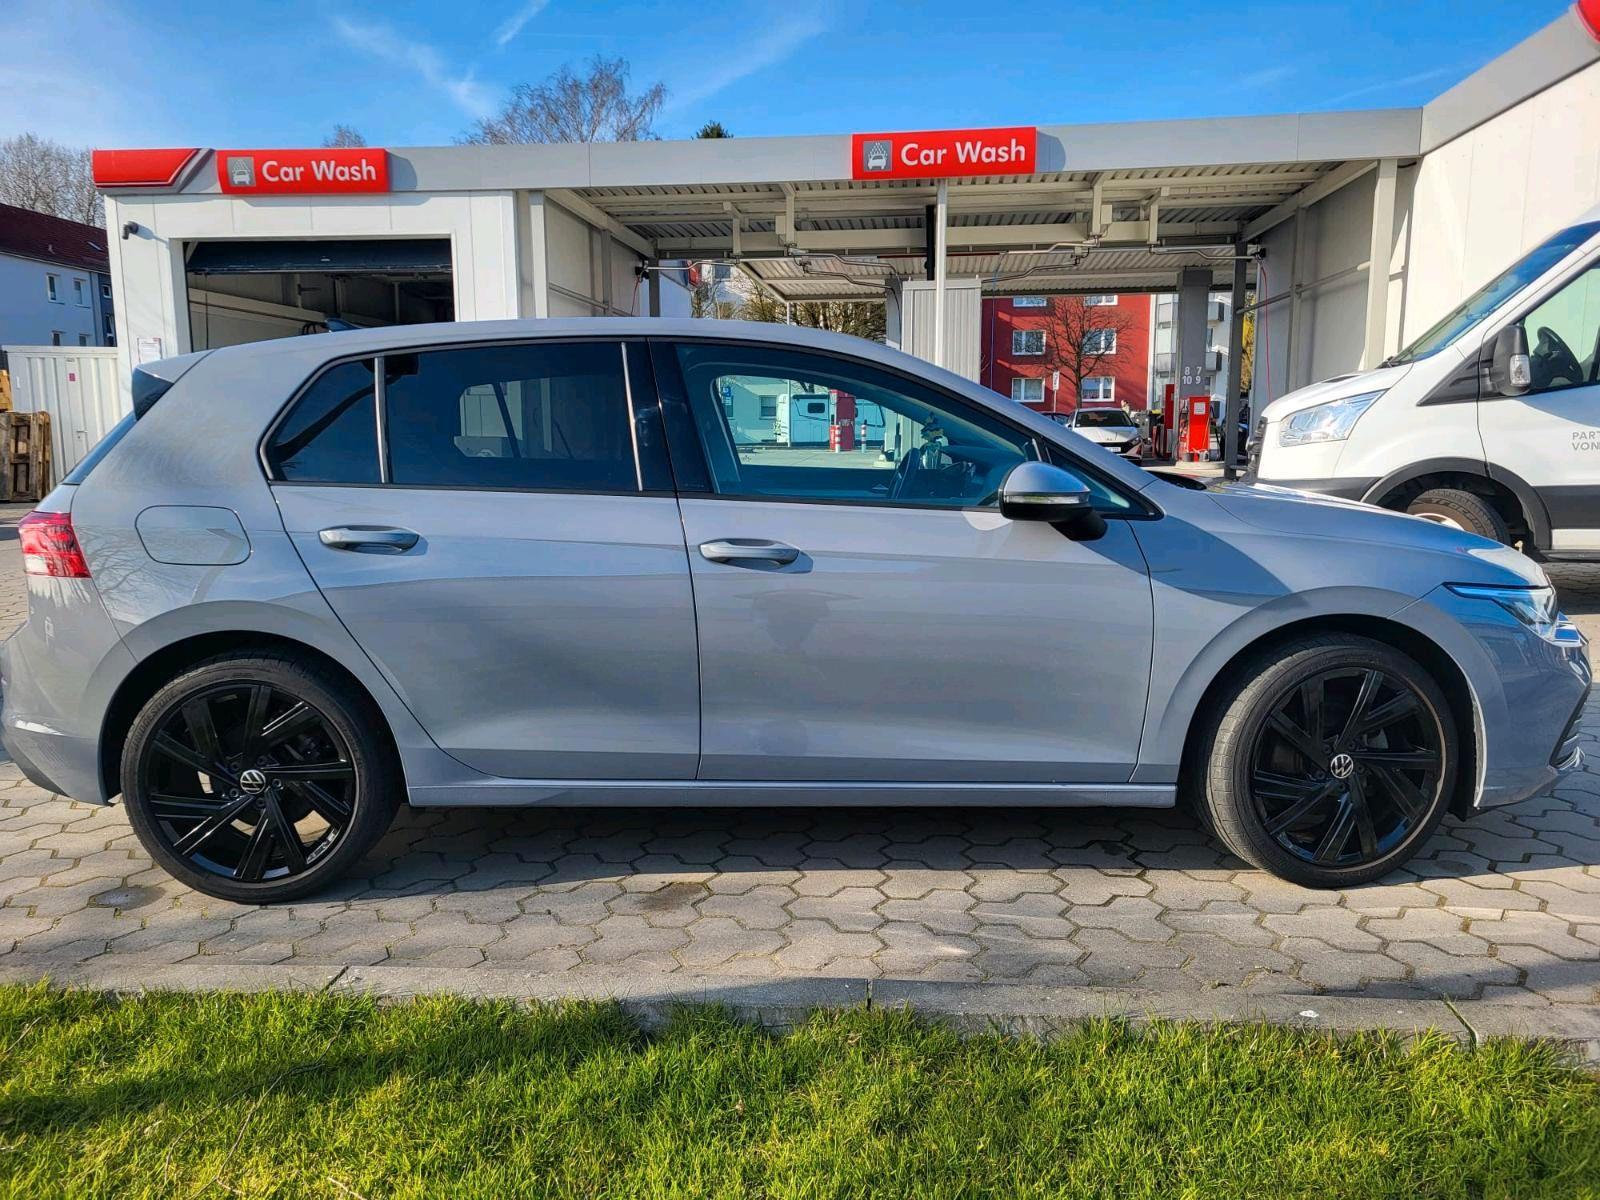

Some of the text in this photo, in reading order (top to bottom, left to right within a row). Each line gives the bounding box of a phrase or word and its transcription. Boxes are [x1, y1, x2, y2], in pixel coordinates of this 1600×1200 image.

[901, 138, 1026, 166] Car Wash
[262, 159, 376, 182] Car Wash
[1184, 366, 1202, 375] 8 7
[1183, 375, 1201, 384] 10 9
